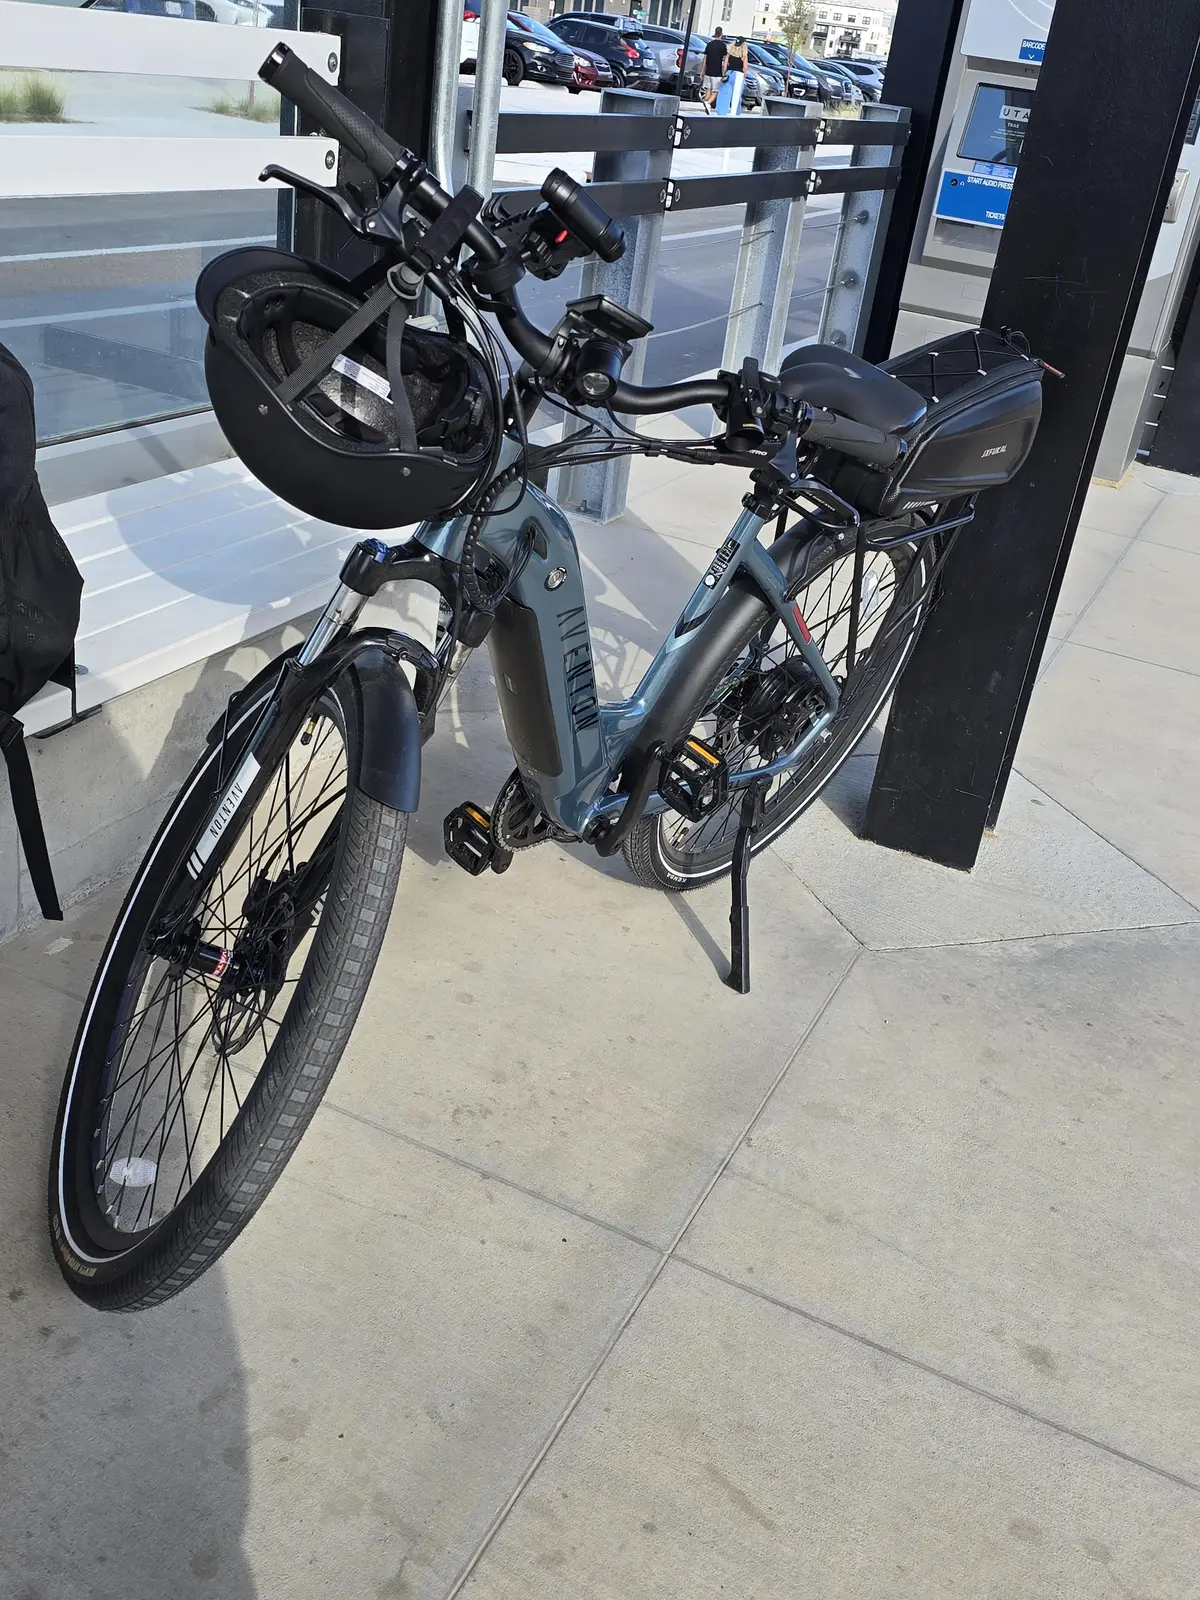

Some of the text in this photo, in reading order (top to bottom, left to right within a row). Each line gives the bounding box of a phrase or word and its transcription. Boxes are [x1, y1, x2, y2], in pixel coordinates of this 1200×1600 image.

[1022, 40, 1047, 50] BARCODE
[1003, 108, 1029, 119] UTA
[967, 176, 1014, 190] START AUDIO PRESS
[985, 210, 1006, 220] TICKETS
[556, 605, 599, 734] AVENTON
[209, 782, 244, 839] AVENTON
